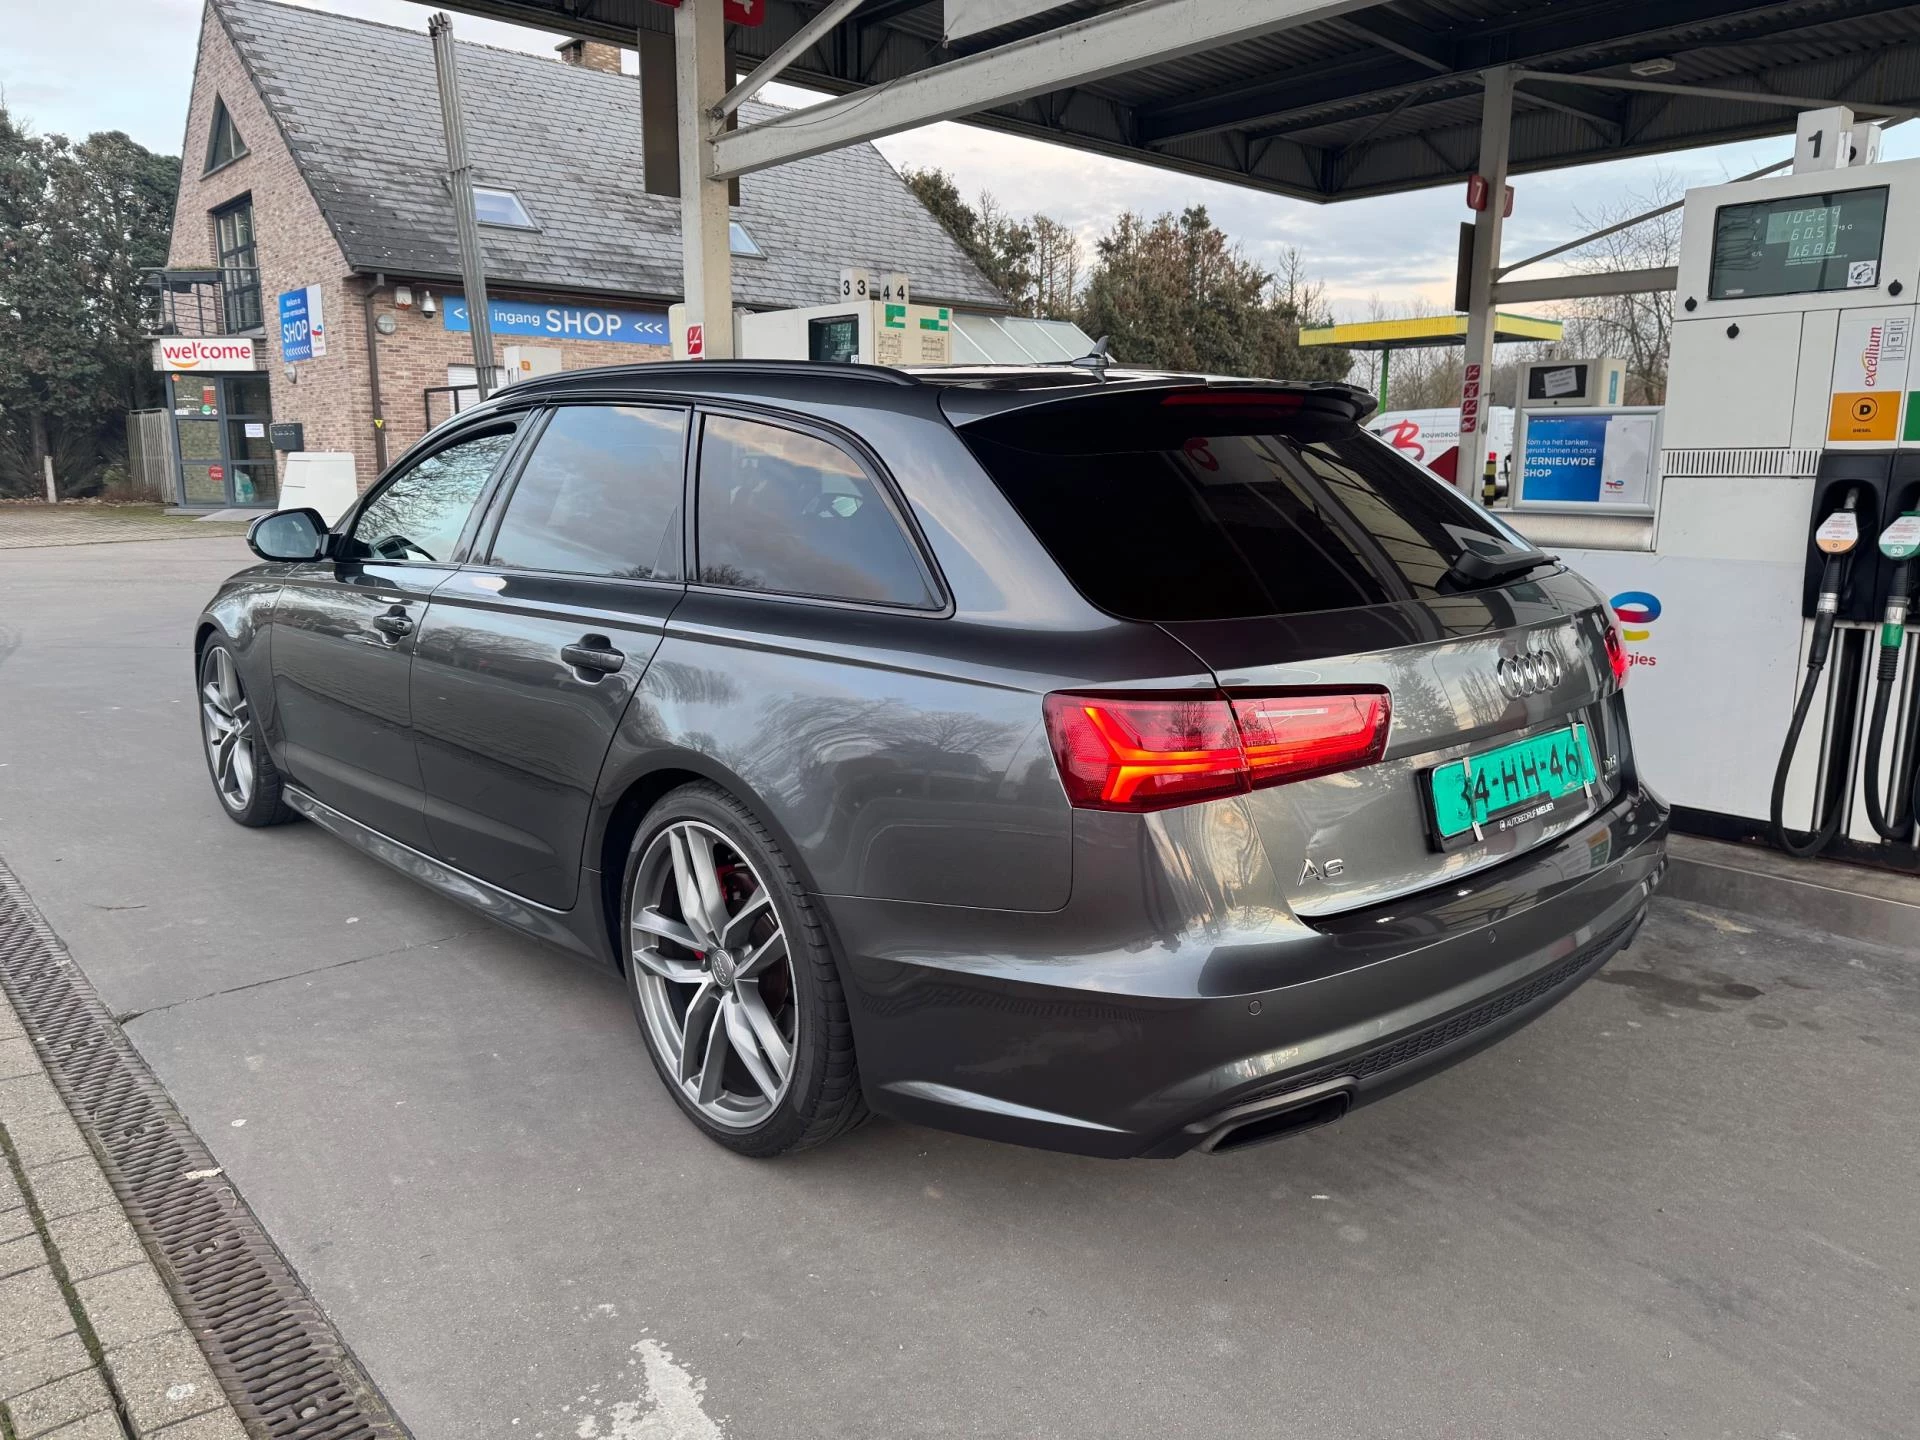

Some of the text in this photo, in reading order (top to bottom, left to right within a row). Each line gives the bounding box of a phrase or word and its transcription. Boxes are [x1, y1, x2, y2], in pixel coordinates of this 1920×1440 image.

[1808, 130, 1823, 158] 1
[843, 279, 850, 296] 3
[857, 279, 866, 296] 3
[883, 285, 890, 300] 4
[896, 285, 905, 300] 4
[494, 308, 623, 337] ingang SHOP
[283, 319, 308, 344] SHOP
[1864, 326, 1882, 387] excellium
[1859, 404, 1872, 416] D
[1421, 431, 1459, 439] BOUWDROG
[1551, 438, 1564, 446] het
[1564, 438, 1589, 446] tanken
[1547, 446, 1571, 454] binnen
[1571, 446, 1578, 454] in
[1525, 456, 1596, 466] VERNIEUWDE
[1524, 468, 1552, 477] SHOP
[1296, 858, 1344, 888] A6
